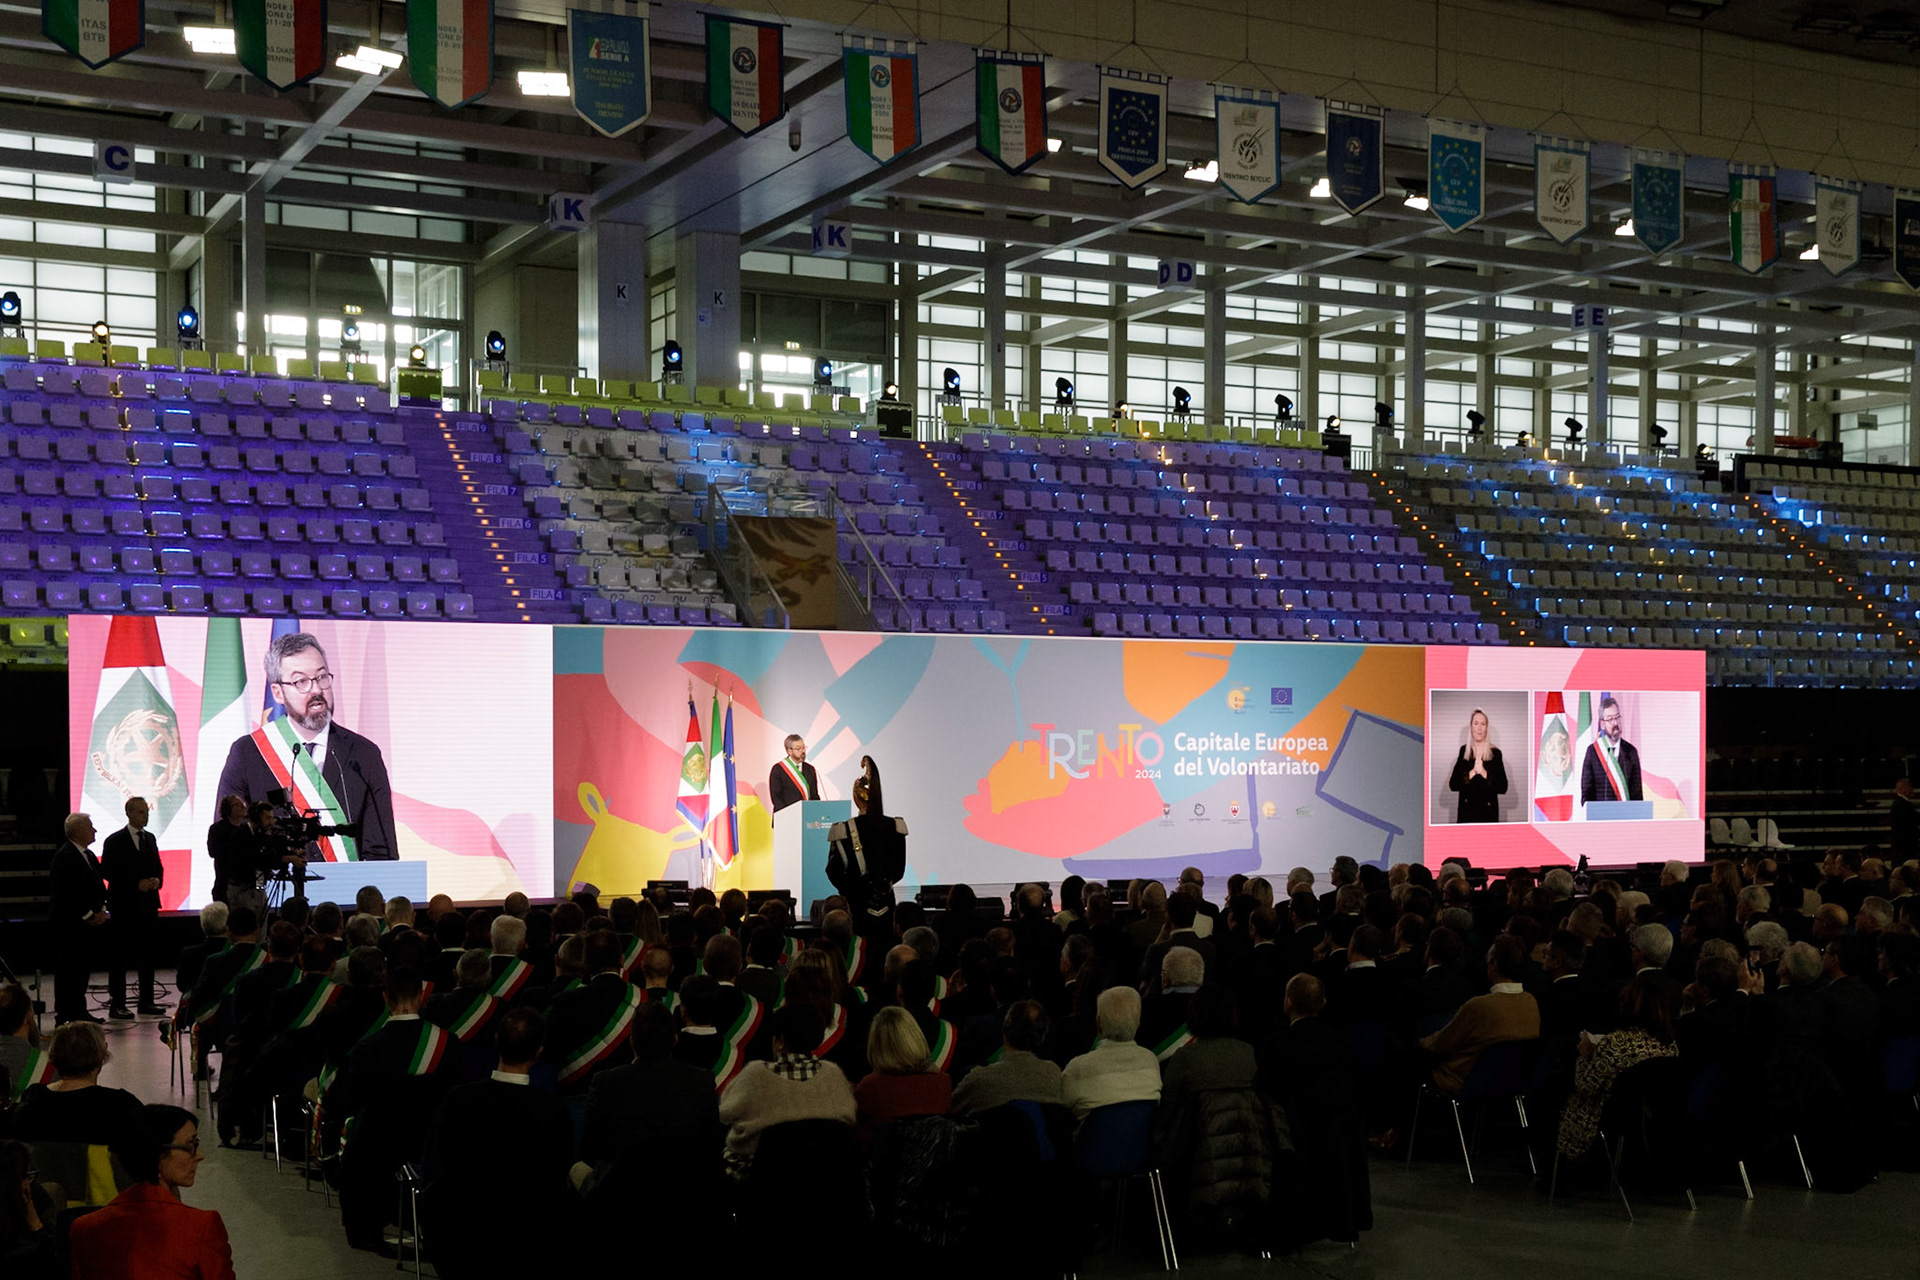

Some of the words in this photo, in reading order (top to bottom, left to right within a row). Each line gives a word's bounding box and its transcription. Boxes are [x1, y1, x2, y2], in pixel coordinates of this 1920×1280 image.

[266, 2, 287, 11] NDER
[81, 19, 107, 30] ITAS
[83, 32, 105, 42] BTB
[600, 52, 622, 61] SERIE
[623, 53, 630, 62] A
[104, 145, 129, 171] C
[1136, 156, 1155, 164] VOLLEY
[1223, 172, 1249, 181] TRENTINO
[1250, 175, 1272, 183] BETCLIC
[550, 199, 557, 223] K
[563, 198, 585, 222] K
[813, 226, 822, 249] K
[828, 225, 846, 247] K
[1160, 263, 1170, 284] D
[1177, 262, 1192, 282] D
[617, 284, 626, 299] K
[714, 291, 723, 305] K
[1574, 308, 1584, 327] E
[1592, 308, 1604, 326] E
[458, 422, 479, 432] FILA
[471, 453, 494, 463] FILA
[486, 485, 507, 494] FILA
[979, 510, 996, 519] FILA
[500, 519, 522, 528] FILA
[1000, 541, 1018, 549] FILA
[516, 554, 538, 563] FILA
[1022, 573, 1039, 581] FILA
[532, 590, 554, 599] FILA
[1045, 605, 1062, 614] FILA
[1173, 731, 1250, 756] Capitale
[1254, 732, 1328, 755] Europea
[1030, 723, 1165, 780] TRENTO
[1173, 756, 1203, 776] del
[1206, 756, 1320, 776] Volontariato
[1135, 769, 1162, 779] 2024
